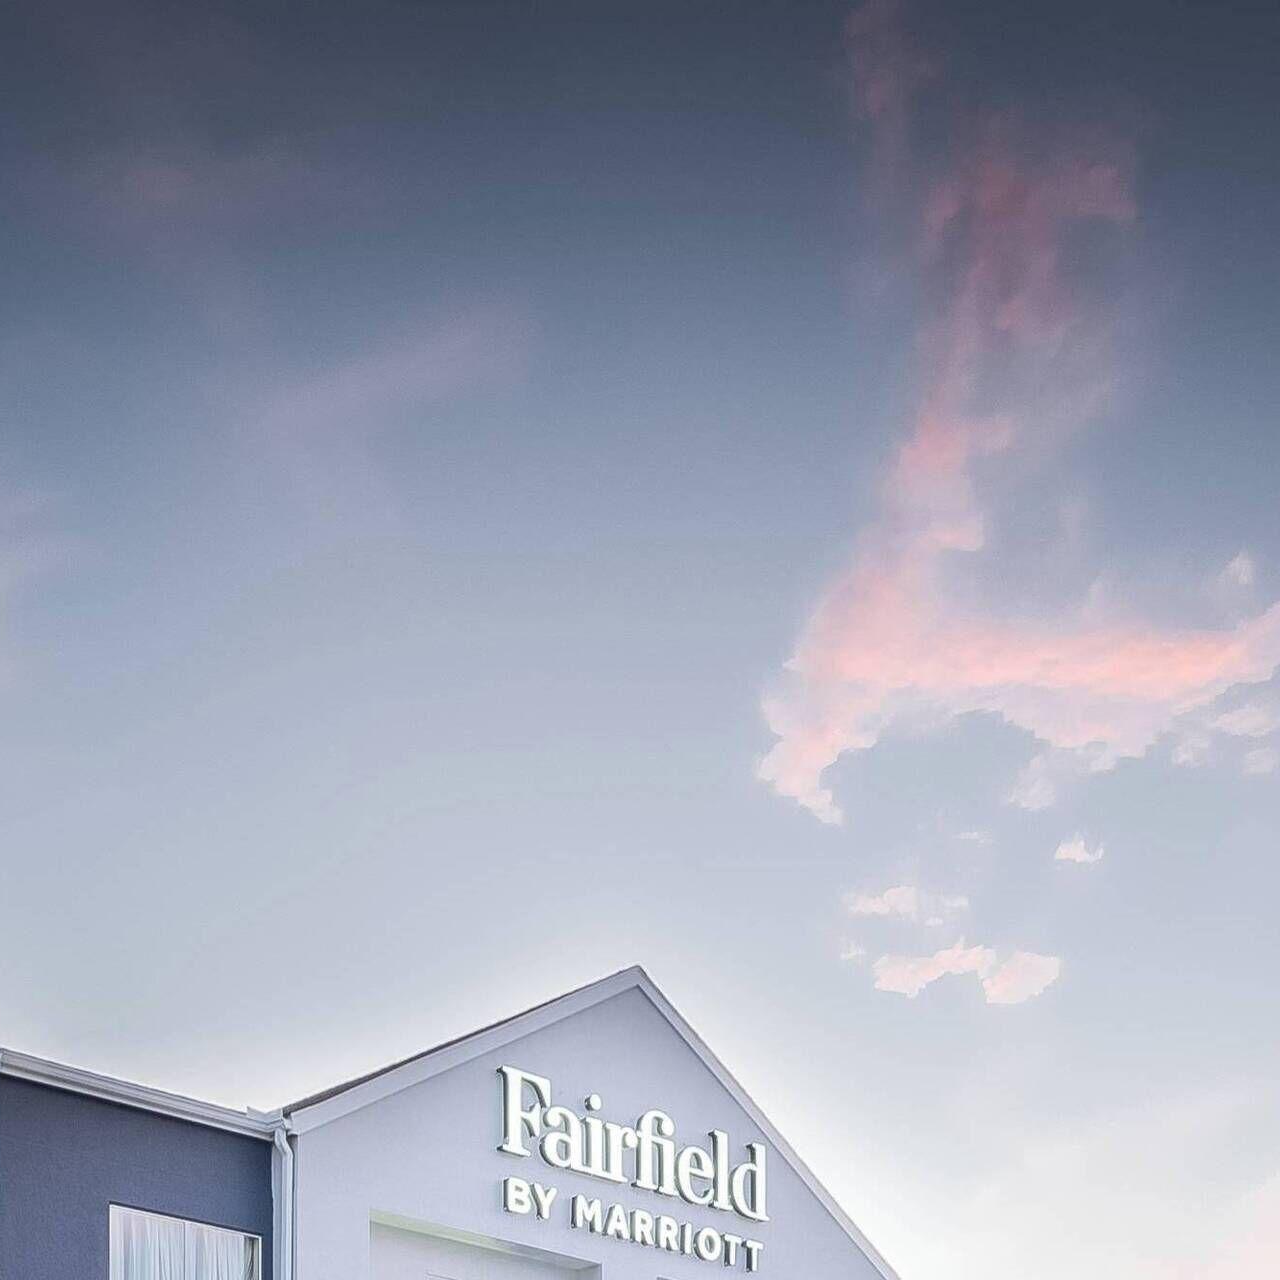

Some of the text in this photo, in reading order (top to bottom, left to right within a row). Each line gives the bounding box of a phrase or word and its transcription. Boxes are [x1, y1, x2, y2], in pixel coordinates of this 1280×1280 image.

[496, 1065, 770, 1222] Fairfield
[503, 1177, 765, 1272] BY MARRIOTT
